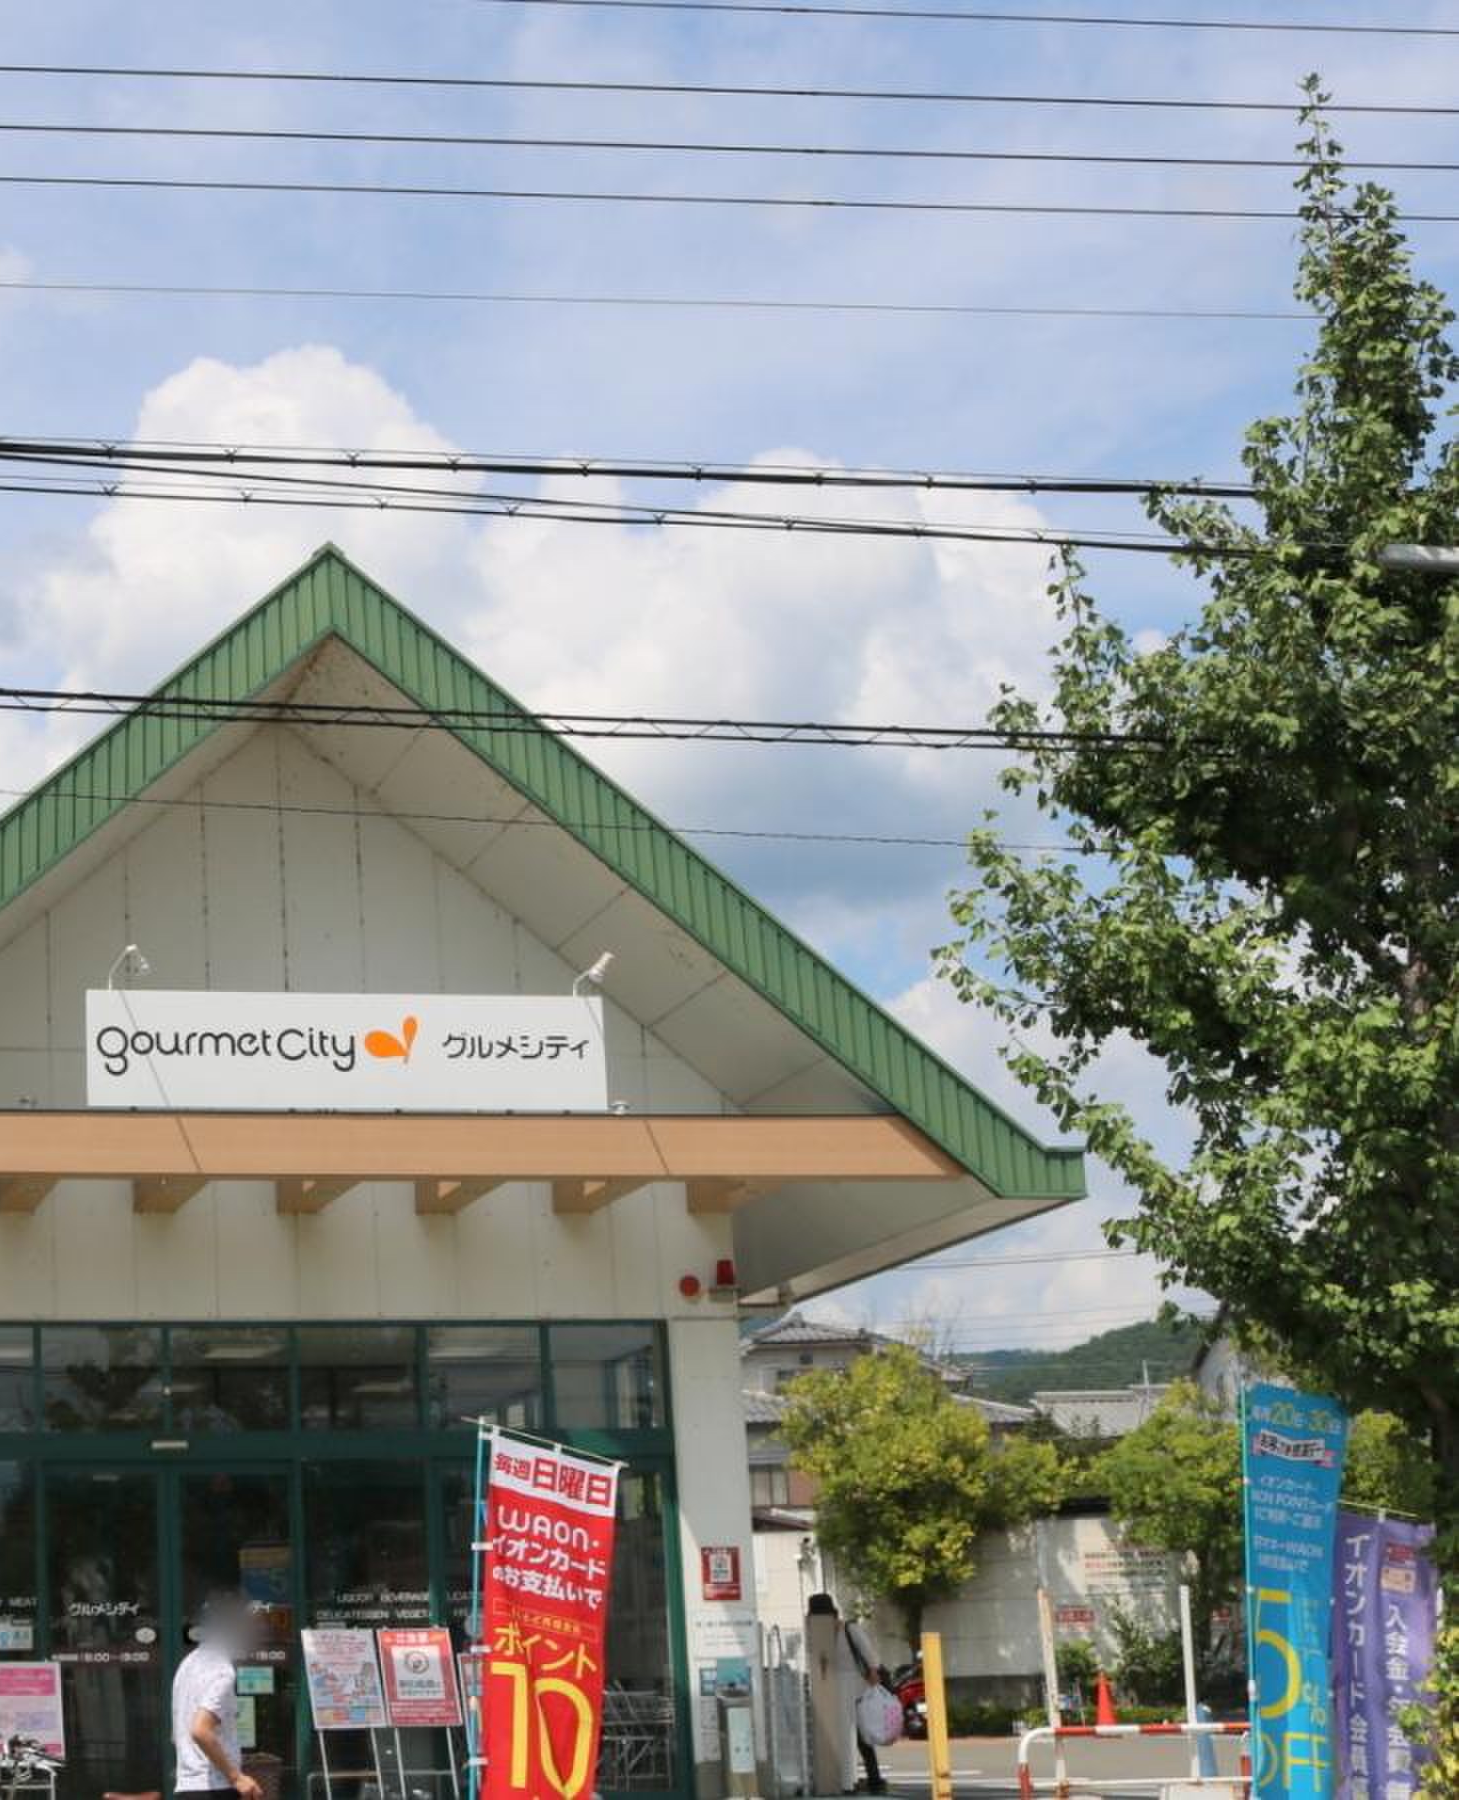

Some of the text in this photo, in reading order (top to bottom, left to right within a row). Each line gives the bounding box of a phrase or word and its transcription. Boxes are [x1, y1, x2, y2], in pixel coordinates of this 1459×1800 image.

[442, 1033, 590, 1060] グルメシティ
[494, 1452, 613, 1508] 毎週日曜日
[492, 1534, 607, 1581] イオンカード
[67, 1601, 141, 1617] グルメシティ
[492, 1621, 598, 1680] ポイント
[490, 1661, 593, 1800] 10
